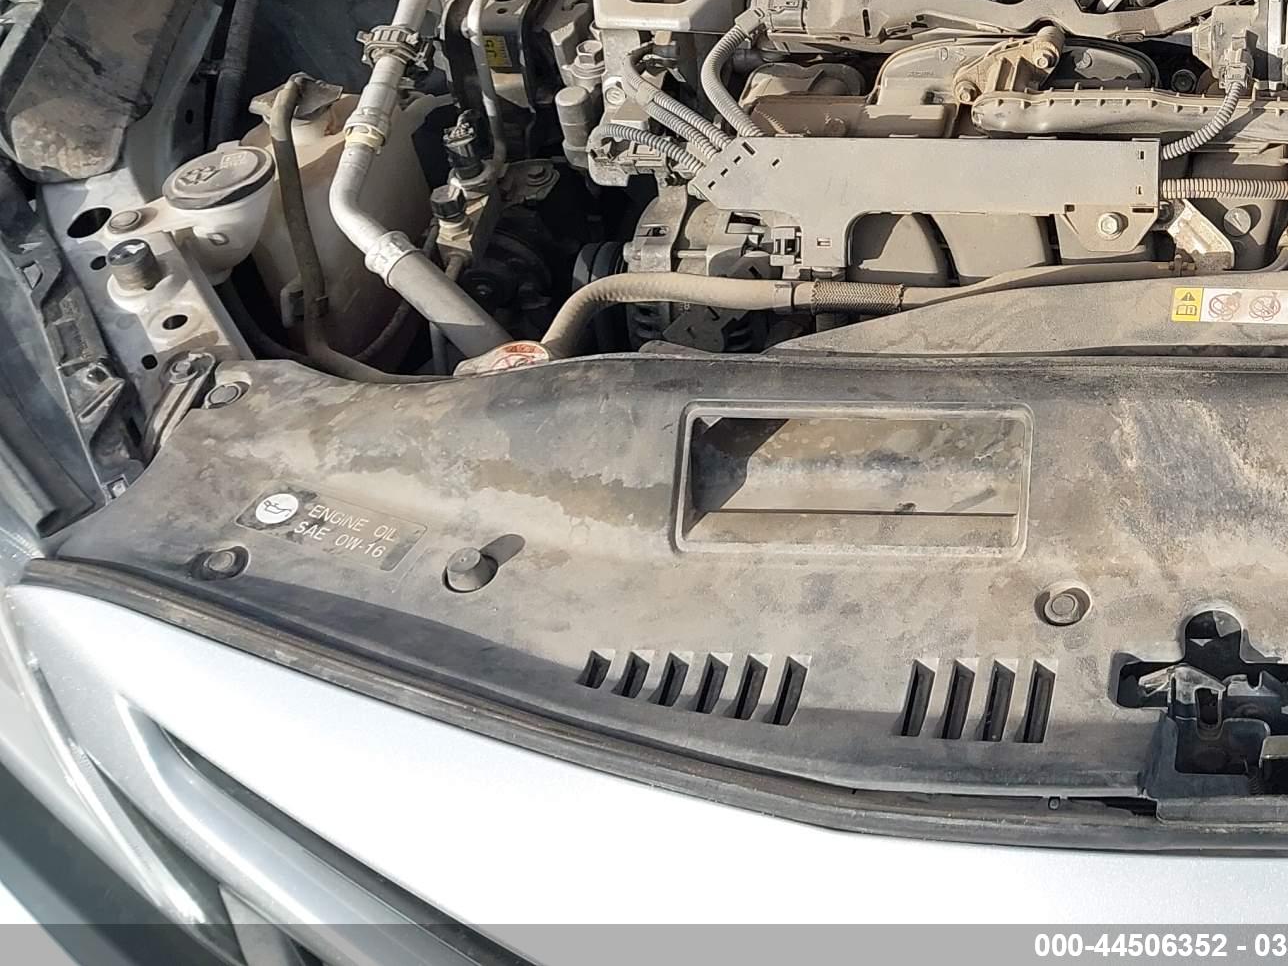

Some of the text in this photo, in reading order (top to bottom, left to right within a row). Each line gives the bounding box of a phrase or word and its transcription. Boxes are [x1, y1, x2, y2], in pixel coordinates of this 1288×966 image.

[294, 521, 386, 558] SAE 0W-16
[308, 504, 398, 542] ENGINE OIL
